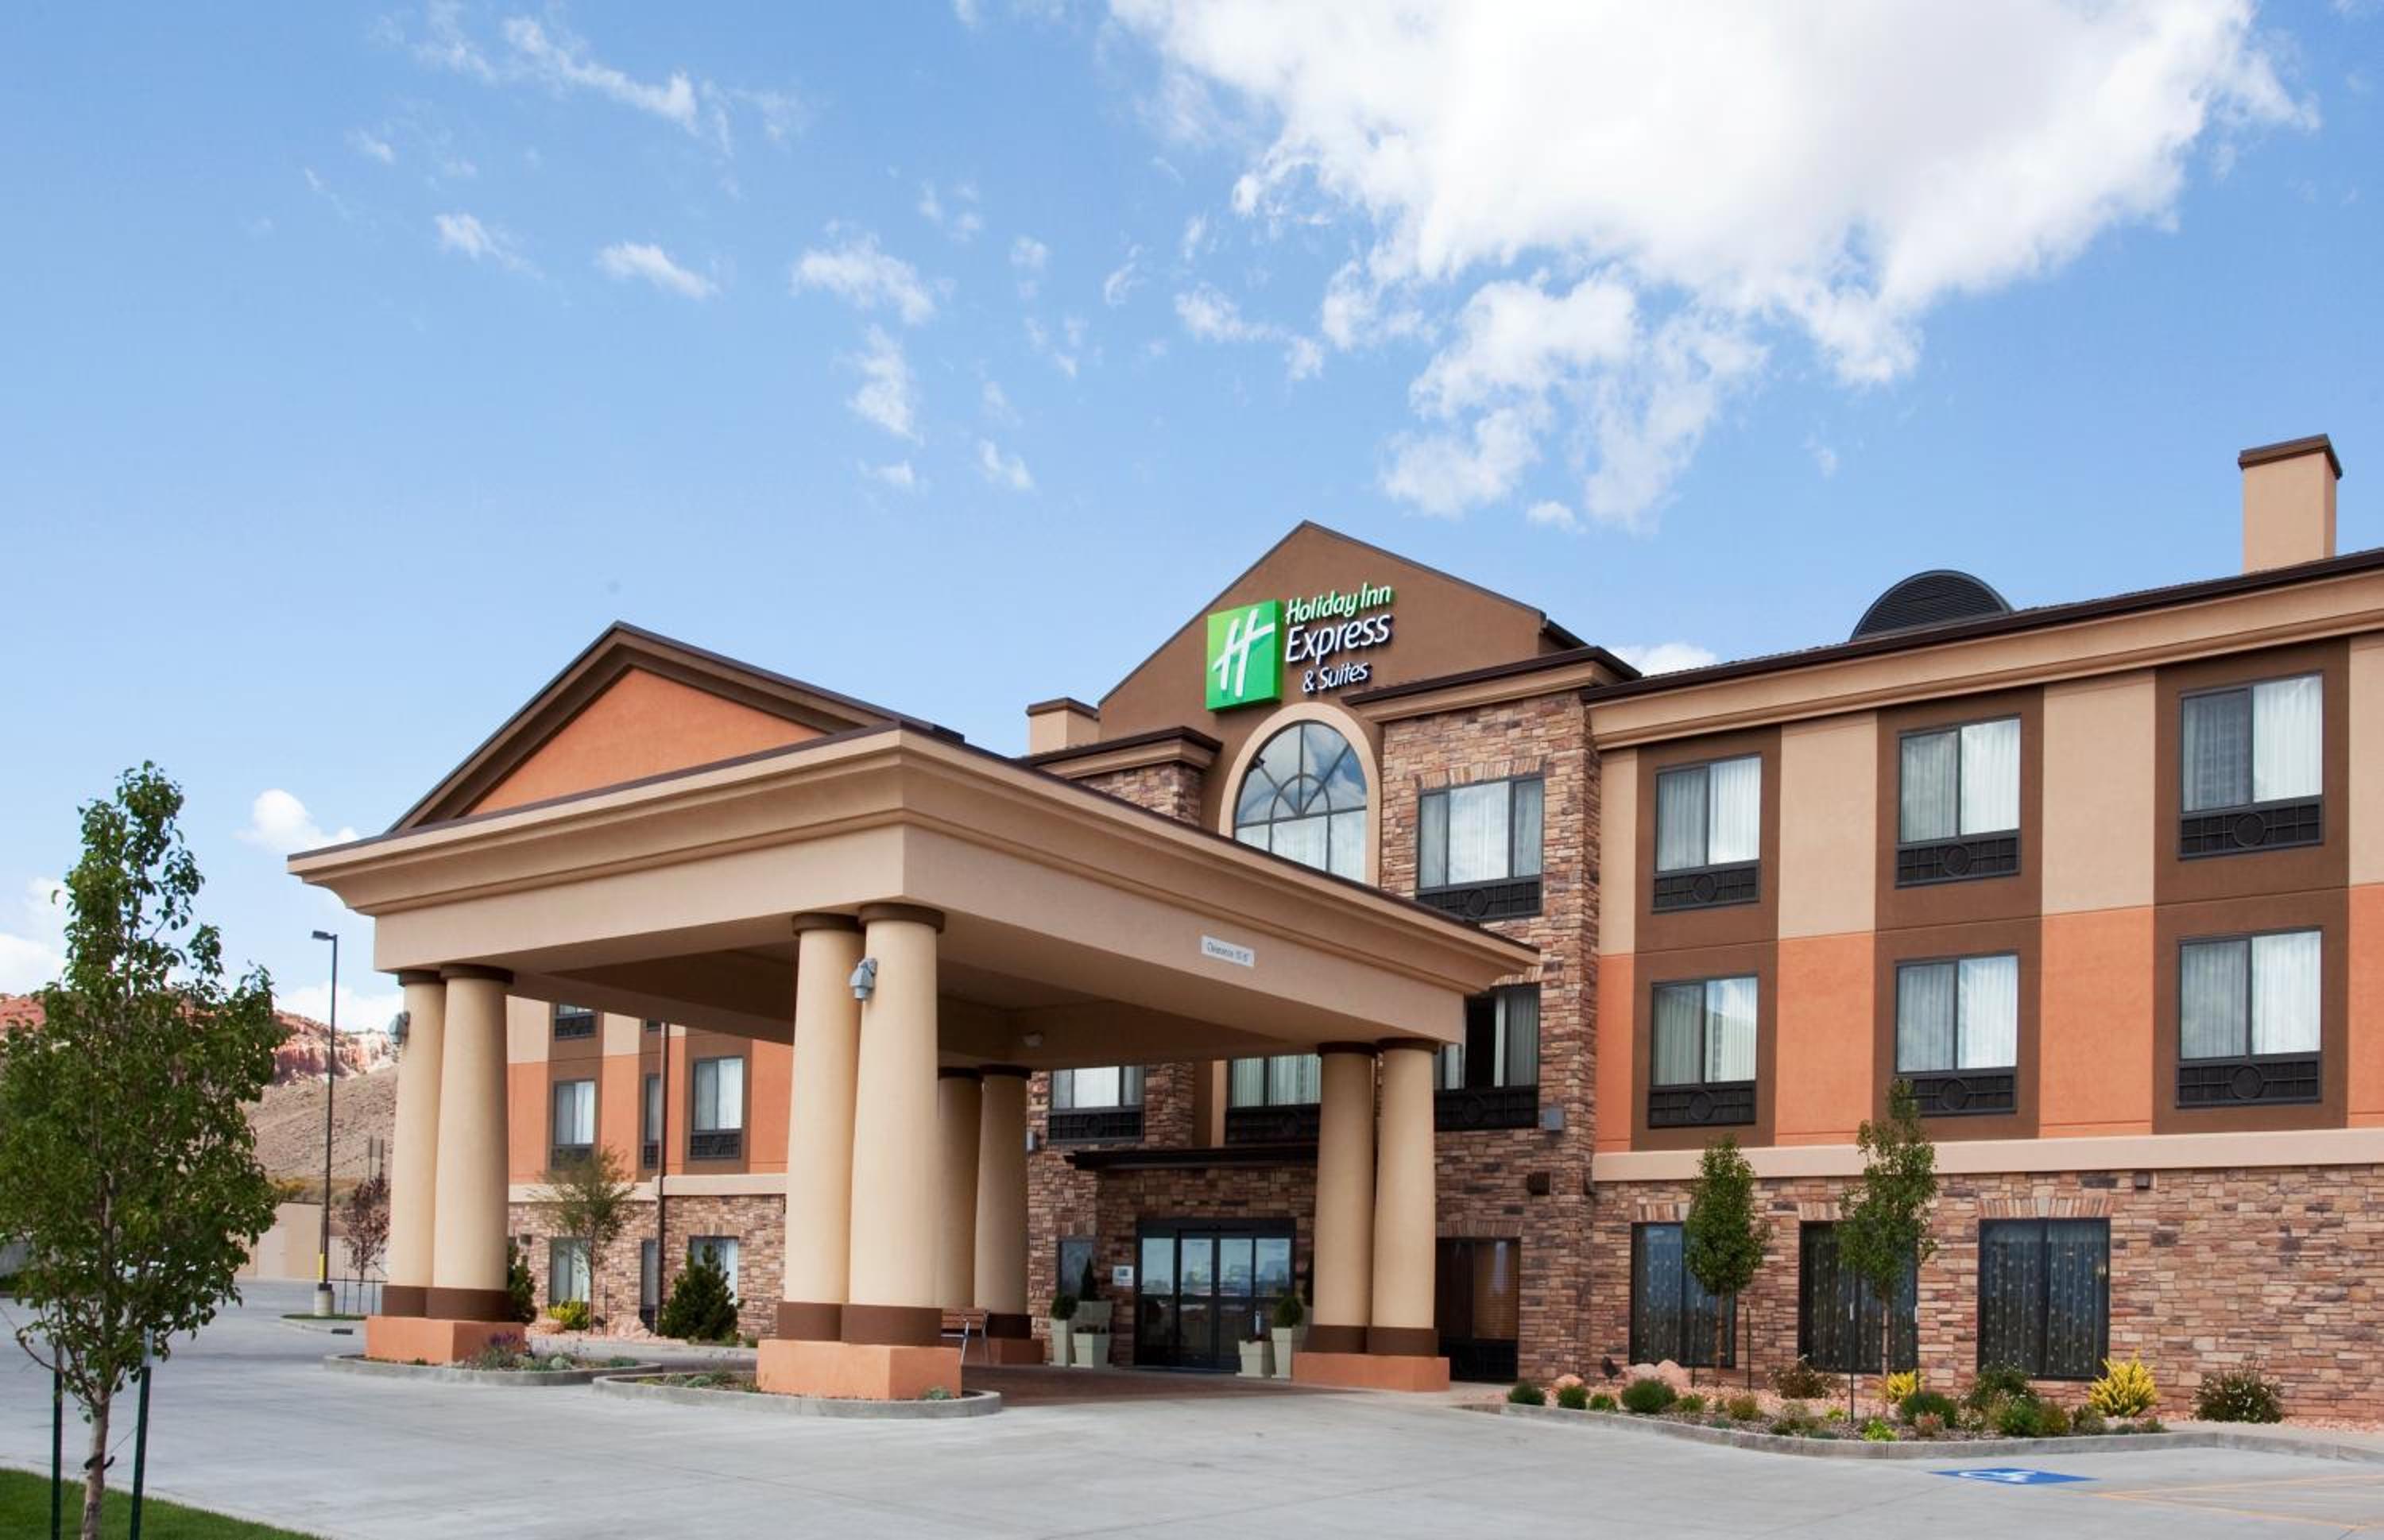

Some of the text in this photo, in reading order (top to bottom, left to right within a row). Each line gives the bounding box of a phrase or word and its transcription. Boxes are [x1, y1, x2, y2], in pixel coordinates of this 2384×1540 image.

[1285, 582, 1391, 625] Holiday Inn
[1285, 614, 1391, 665] Express
[1302, 662, 1368, 693] & Suites
